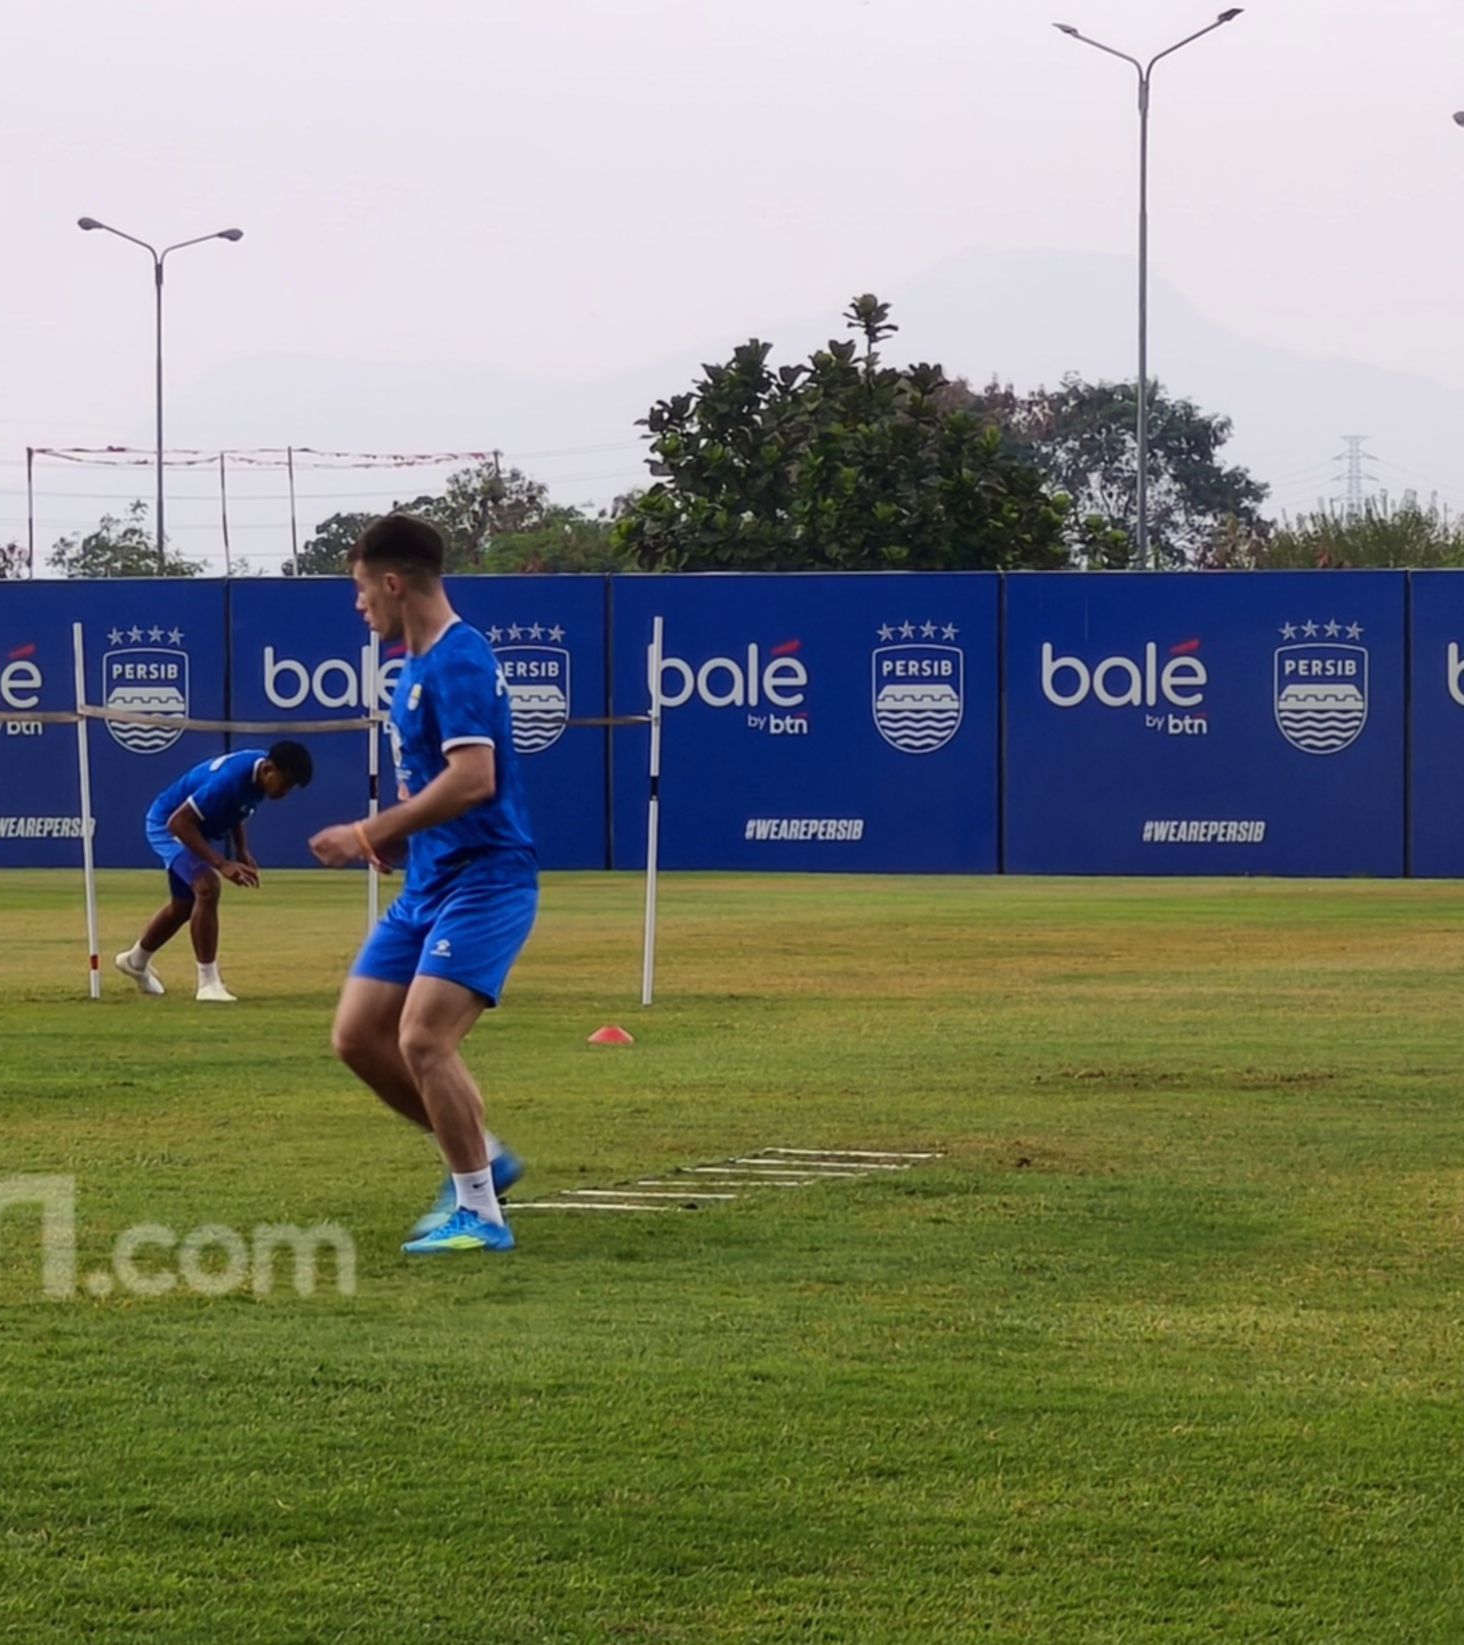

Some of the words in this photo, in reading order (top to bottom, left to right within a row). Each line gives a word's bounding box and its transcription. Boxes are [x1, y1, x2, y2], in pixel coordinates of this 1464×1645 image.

[111, 662, 178, 680] PERSIB
[503, 660, 560, 678] ERSIB
[882, 659, 953, 678] PERSIB
[1041, 638, 1207, 707] balé
[1284, 659, 1357, 677] PERSIB
[747, 714, 767, 730] by
[769, 714, 808, 735] btn
[1145, 714, 1165, 731] by
[1168, 713, 1207, 735] btn
[744, 818, 865, 841] #WEAREPERSIB
[1142, 820, 1266, 843] #WEAREPERSIB
